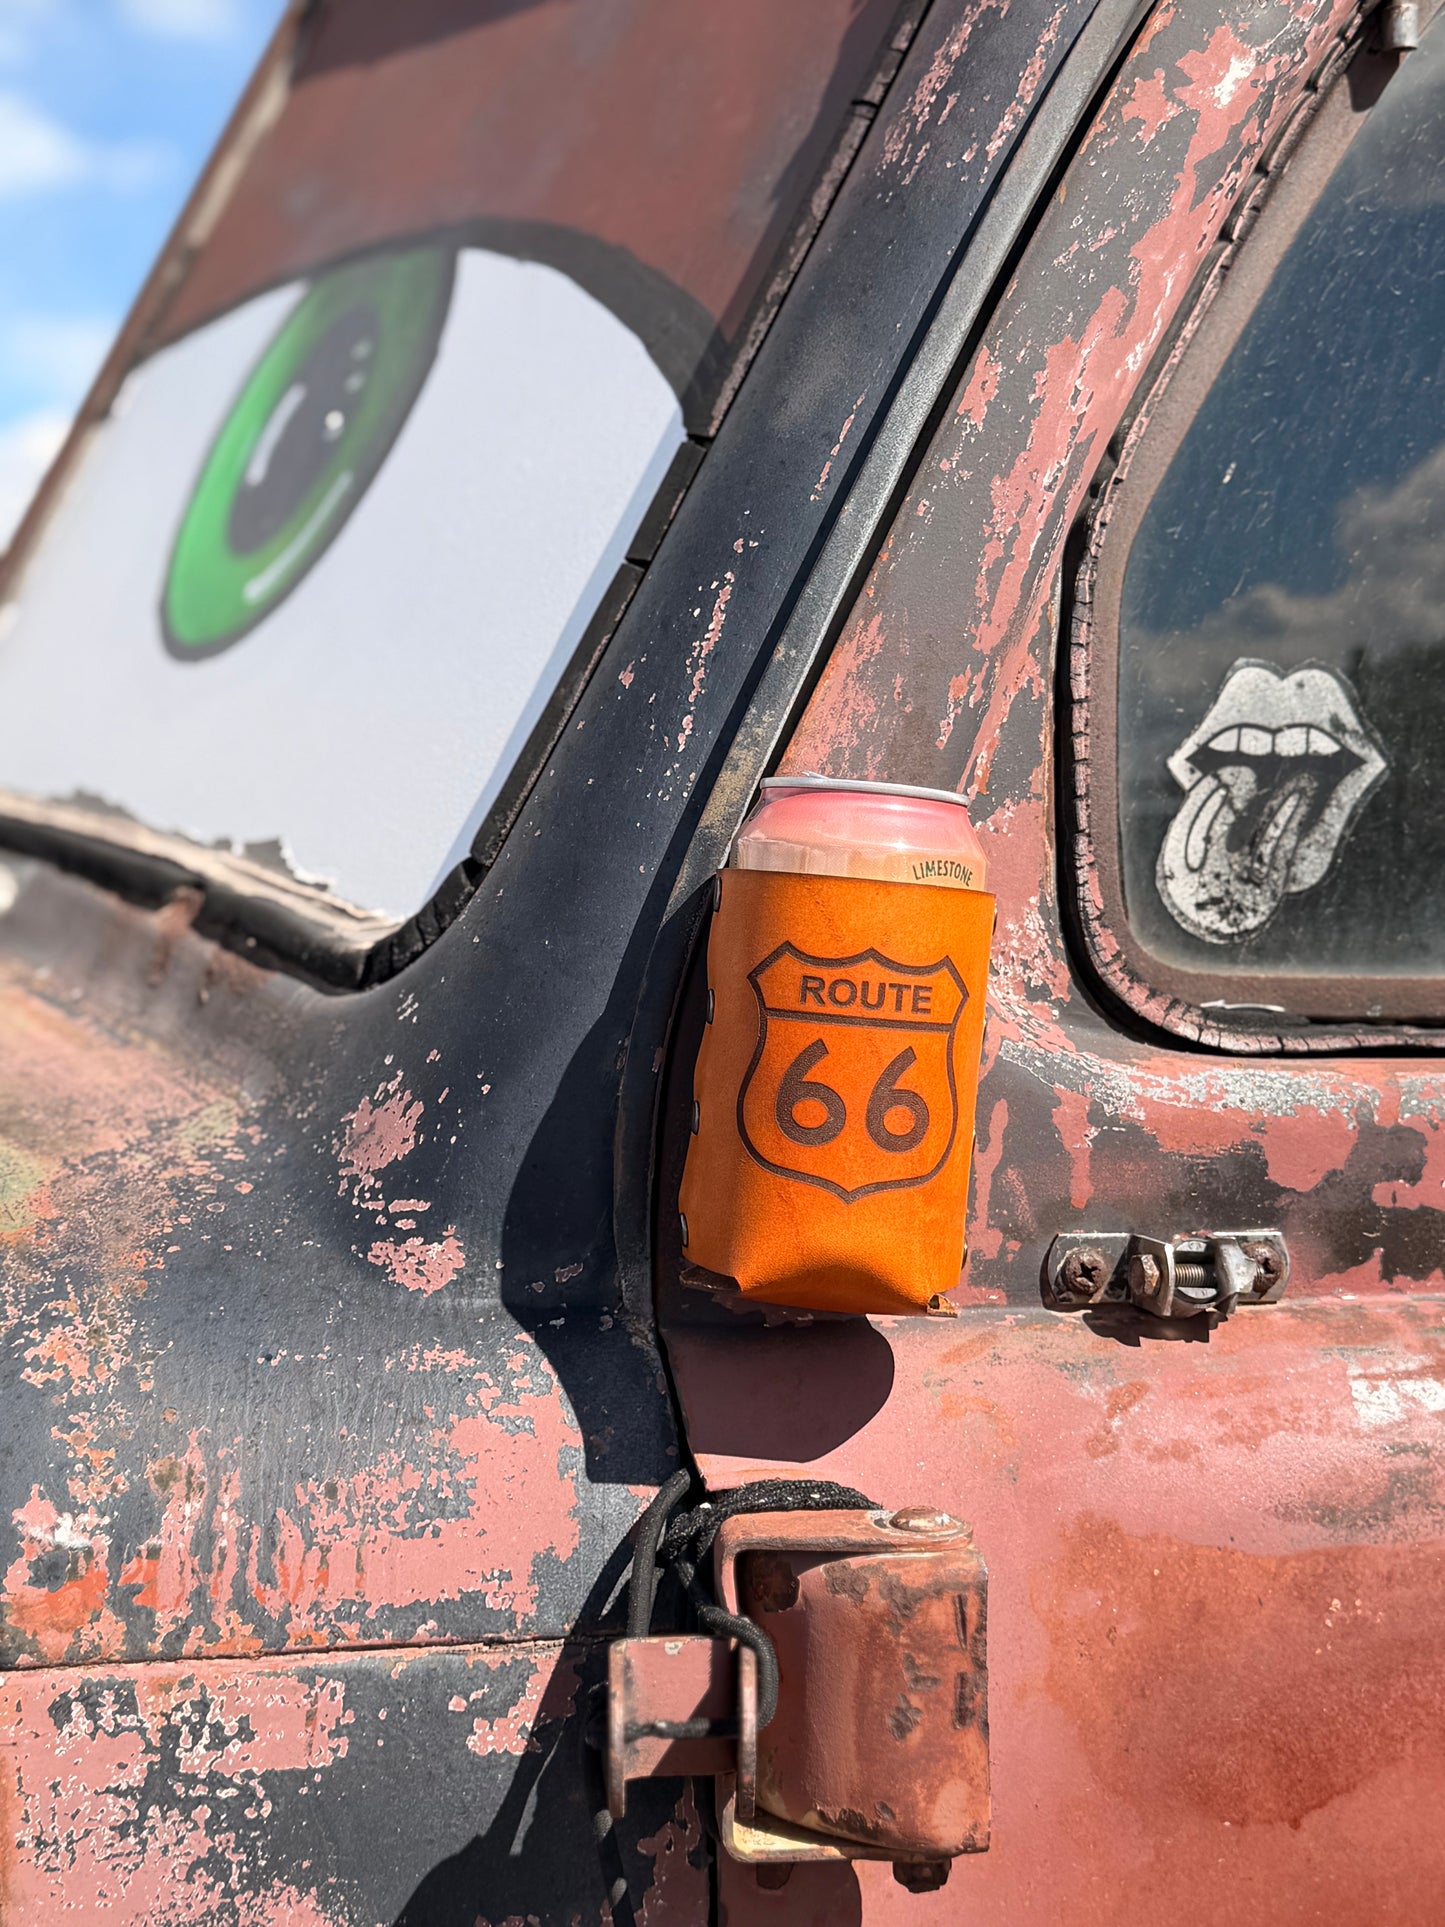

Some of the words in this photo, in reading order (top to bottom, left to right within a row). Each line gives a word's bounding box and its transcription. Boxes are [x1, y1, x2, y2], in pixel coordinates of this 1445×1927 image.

[912, 860, 973, 887] LIMESTONE
[801, 976, 933, 1014] ROUTE
[775, 1038, 929, 1152] 66
